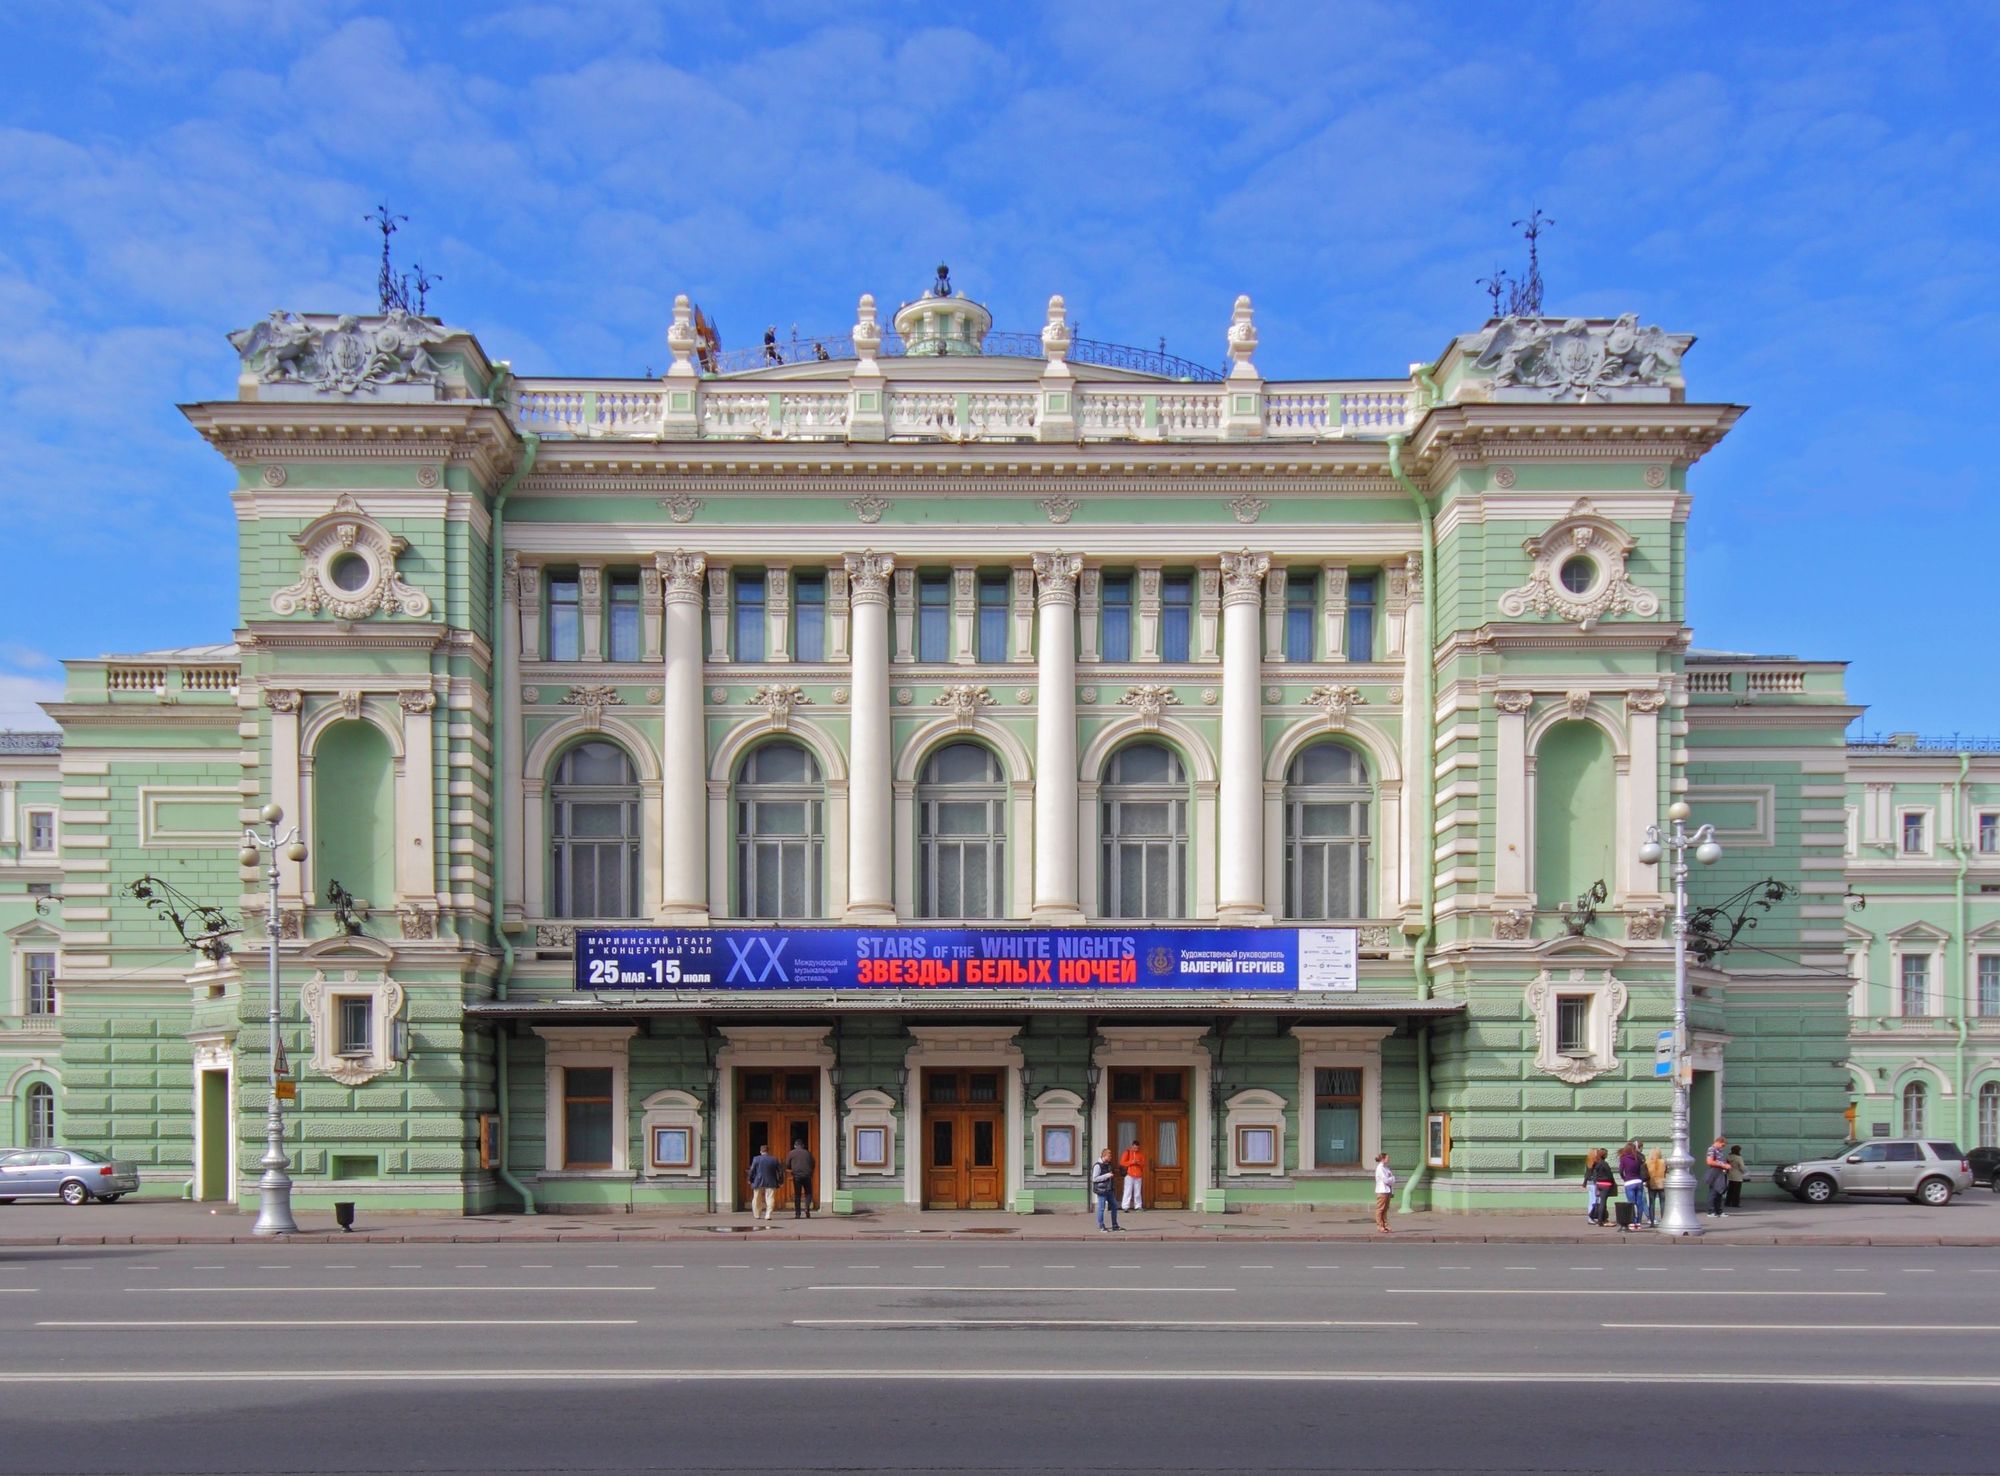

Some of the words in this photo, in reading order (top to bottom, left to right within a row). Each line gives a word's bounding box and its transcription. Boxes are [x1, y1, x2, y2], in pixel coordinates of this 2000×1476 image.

[588, 936, 669, 945] МАРИИНСКИЙ
[676, 937, 713, 945] ТЕАТР
[603, 946, 683, 955] КОНЦЕРТНЫЙ
[690, 946, 712, 955] ЗАЛ
[856, 936, 926, 959] STARS
[933, 946, 948, 958] OF
[952, 946, 975, 958] THE
[981, 937, 1050, 958] WHITE
[1057, 936, 1136, 959] NIGHTS
[725, 937, 790, 983] XX
[1180, 949, 1238, 959] Художественный
[1238, 950, 1285, 960] руководитель
[794, 959, 848, 967] Международный
[1180, 958, 1233, 974] ВАЛЕРИЙ
[1235, 961, 1285, 974] ГЕРГИЕВ
[589, 959, 619, 984] 25
[621, 972, 645, 983] МАЯ
[651, 960, 680, 984] 15
[794, 967, 839, 975] музыкальный
[857, 959, 959, 986] ЗВЕЗДЫ
[966, 959, 1052, 983] БЕЛЫХ
[1059, 954, 1137, 984] НОЧЕЙ
[794, 975, 829, 983] фестиваль
